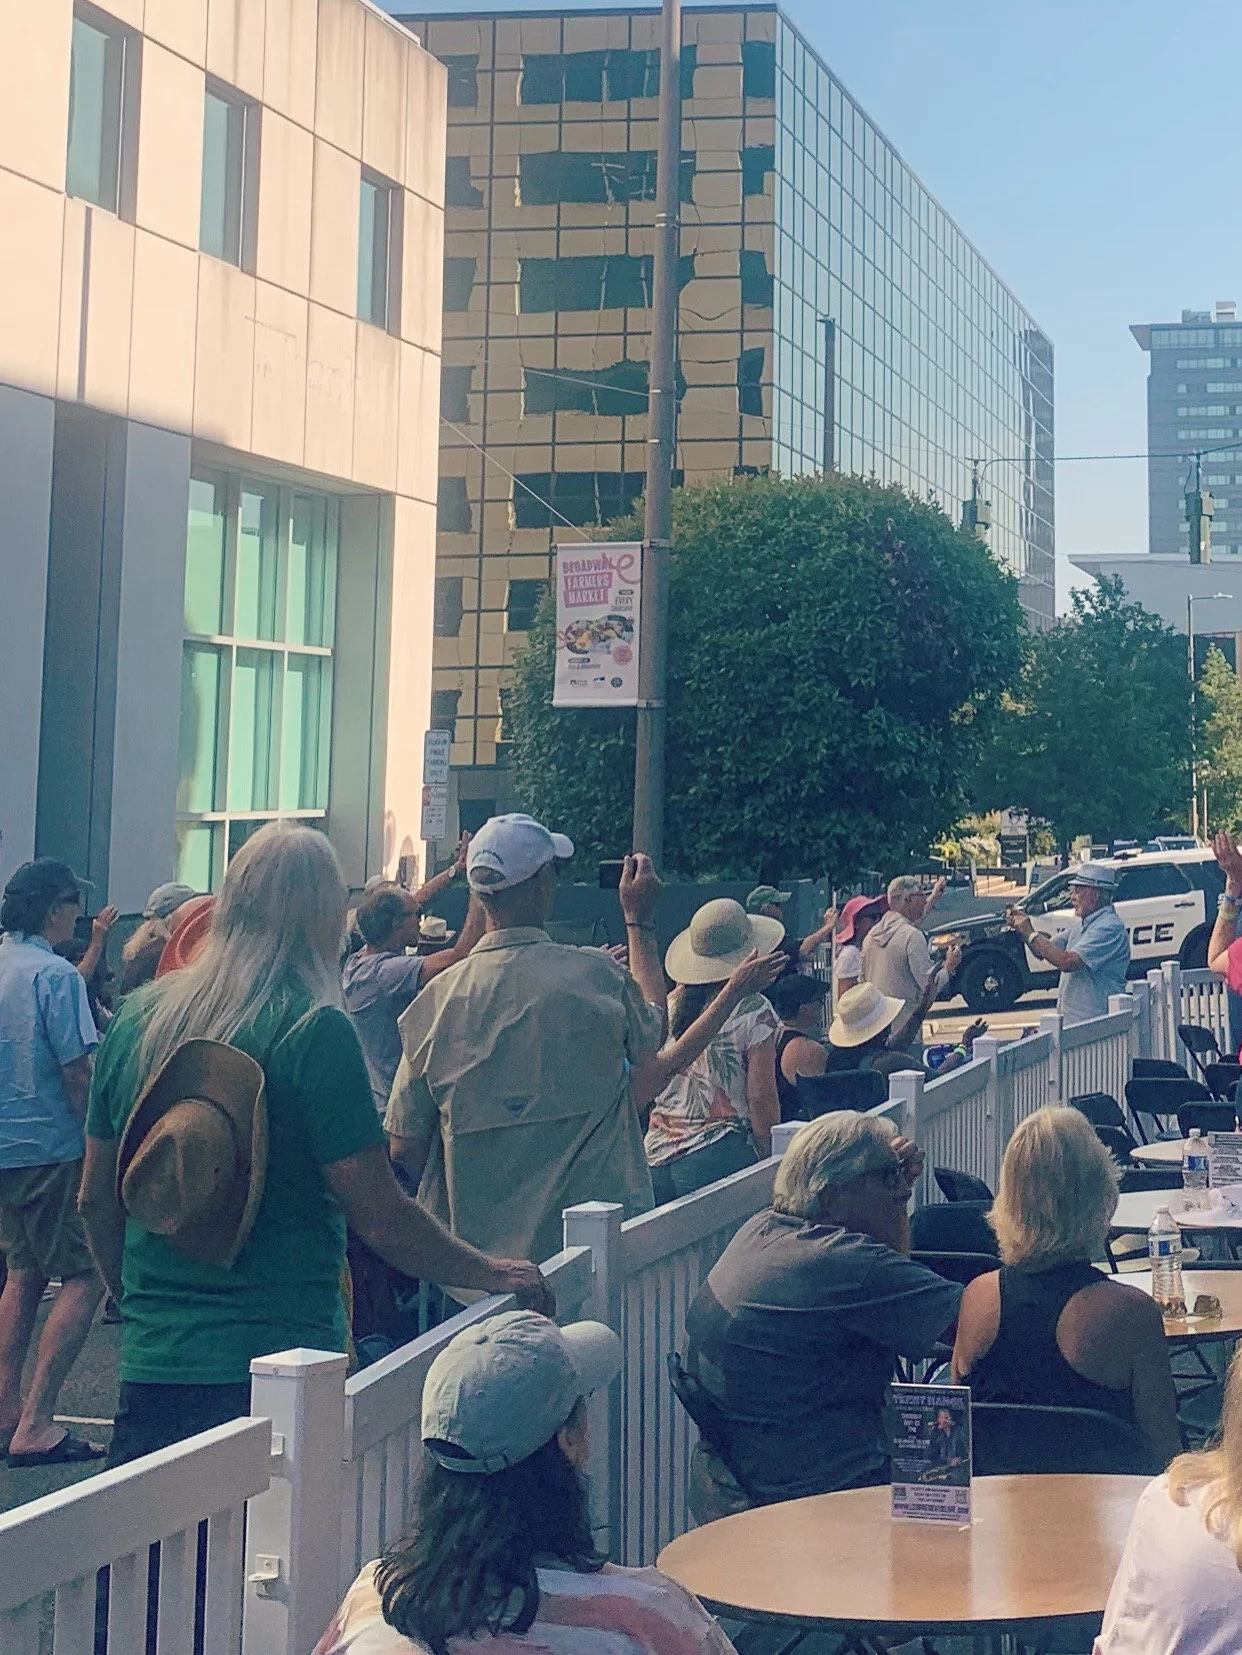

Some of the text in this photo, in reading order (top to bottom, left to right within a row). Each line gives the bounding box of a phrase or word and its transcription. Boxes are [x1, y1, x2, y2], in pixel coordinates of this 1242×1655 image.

[562, 555, 613, 574] BROADWAY
[567, 574, 610, 590] FARMERS
[568, 589, 605, 604] MARKET
